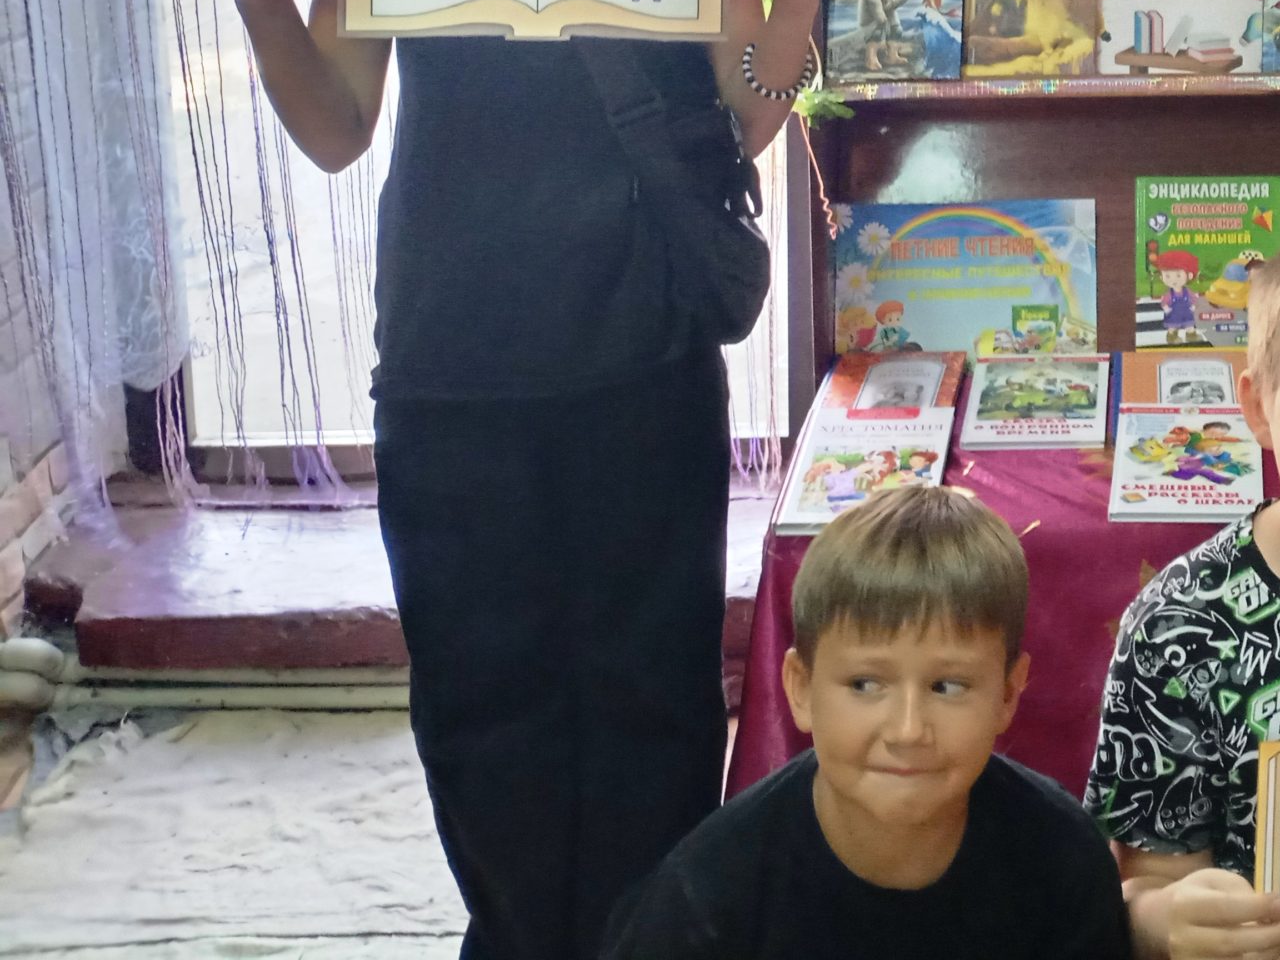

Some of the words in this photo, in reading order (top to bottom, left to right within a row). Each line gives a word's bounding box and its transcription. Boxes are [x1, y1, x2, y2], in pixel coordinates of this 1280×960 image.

[1149, 182, 1270, 200] ЭНЦИКЛОПЕДИЯ
[1168, 233, 1191, 247] ДЛЯ
[1195, 231, 1251, 245] МАЛЫШЕЙ
